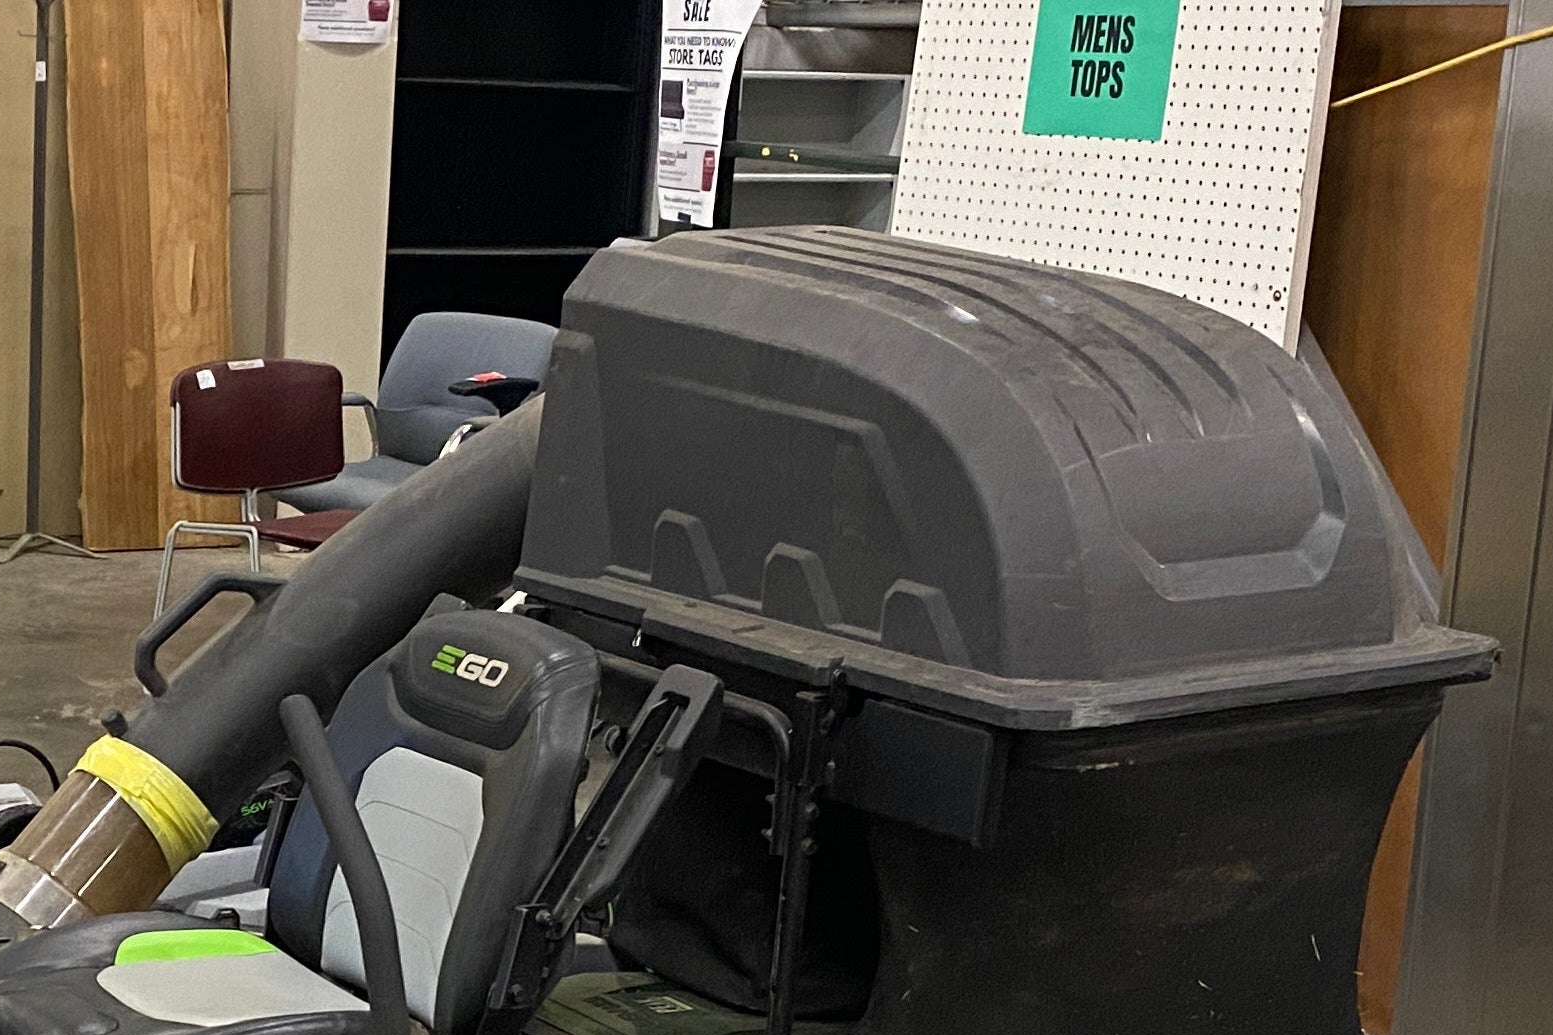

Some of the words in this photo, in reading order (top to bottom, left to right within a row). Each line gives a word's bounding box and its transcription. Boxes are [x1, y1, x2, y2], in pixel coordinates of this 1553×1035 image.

[683, 0, 711, 21] SALE
[687, 36, 702, 46] NEED
[703, 37, 710, 46] TO
[1070, 15, 1136, 53] MENS
[669, 48, 694, 65] STORE
[698, 49, 723, 67] TAGS
[1070, 60, 1125, 98] TOPS
[432, 644, 509, 688] EGO
